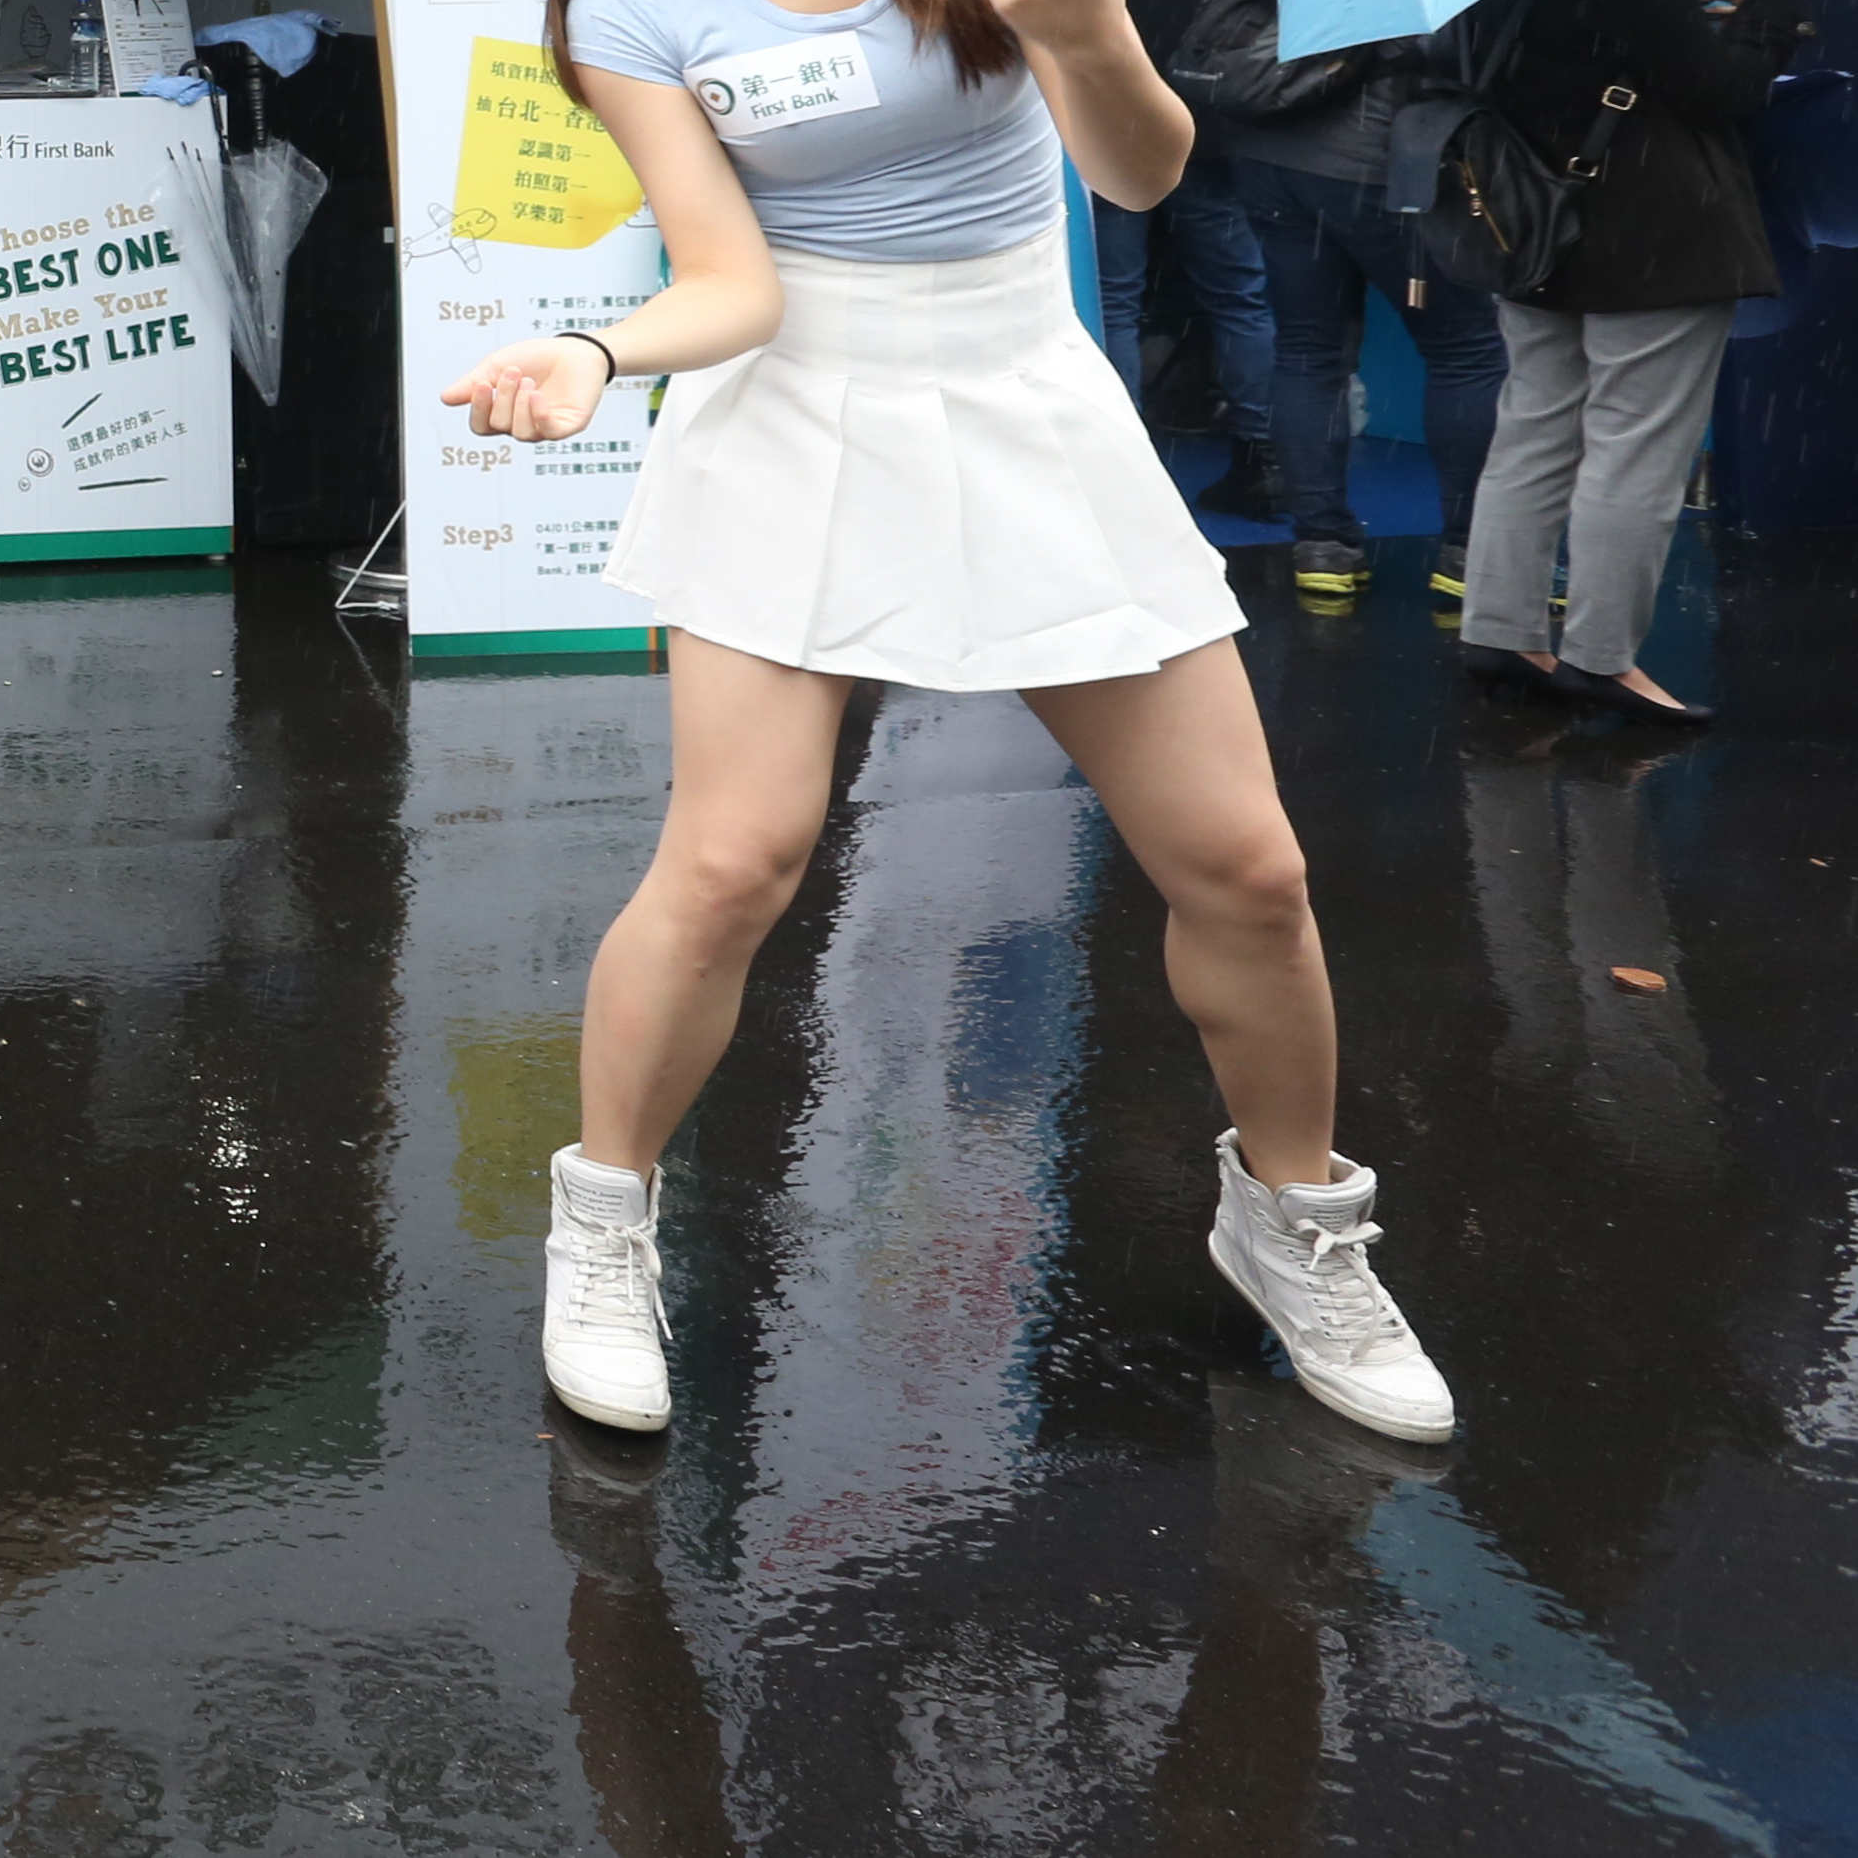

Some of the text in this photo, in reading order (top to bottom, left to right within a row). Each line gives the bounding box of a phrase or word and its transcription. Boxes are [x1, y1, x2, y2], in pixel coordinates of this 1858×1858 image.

[740, 55, 857, 101] 第一銀行
[749, 86, 840, 120] First Bank
[34, 142, 68, 160] First
[73, 140, 115, 160] Bank
[104, 200, 156, 230] the
[96, 229, 182, 279] ONE
[94, 287, 169, 320] Your
[438, 298, 506, 326] Step1
[0, 313, 197, 389] BEST LIFE
[441, 444, 513, 472] Step2
[443, 523, 514, 552] Step3
